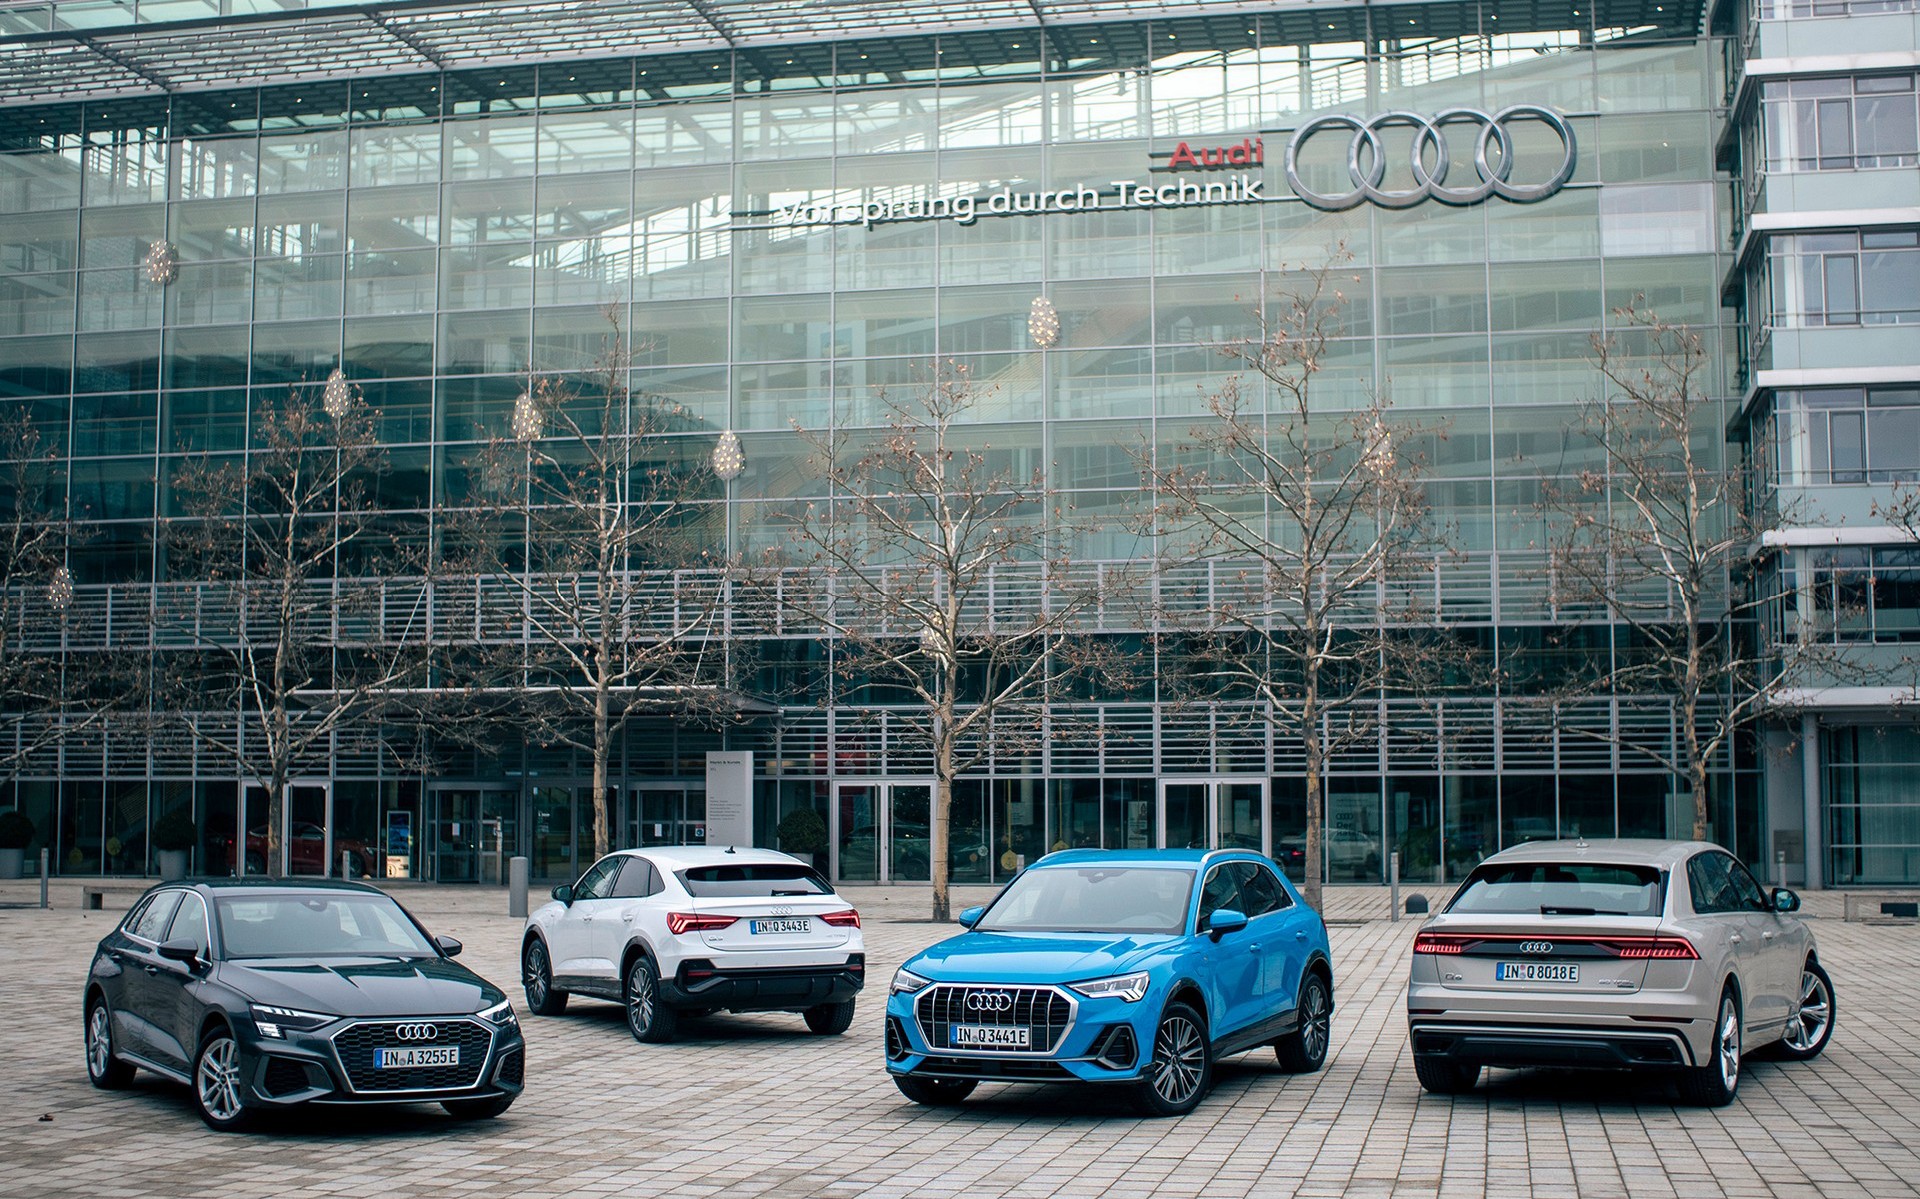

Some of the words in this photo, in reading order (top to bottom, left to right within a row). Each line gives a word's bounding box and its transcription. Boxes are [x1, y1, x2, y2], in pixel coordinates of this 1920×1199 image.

[1168, 137, 1263, 169] Audi
[779, 194, 976, 228] Vorsprung
[988, 183, 1099, 213] durch
[1111, 175, 1264, 203] Technik
[757, 921, 768, 932] IN
[773, 921, 780, 932] Q
[1504, 963, 1520, 978] IN
[1526, 965, 1535, 980] Q
[958, 1028, 971, 1042] IN
[978, 1029, 986, 1043] Q
[384, 1051, 399, 1066] IN
[407, 1050, 414, 1065] A
